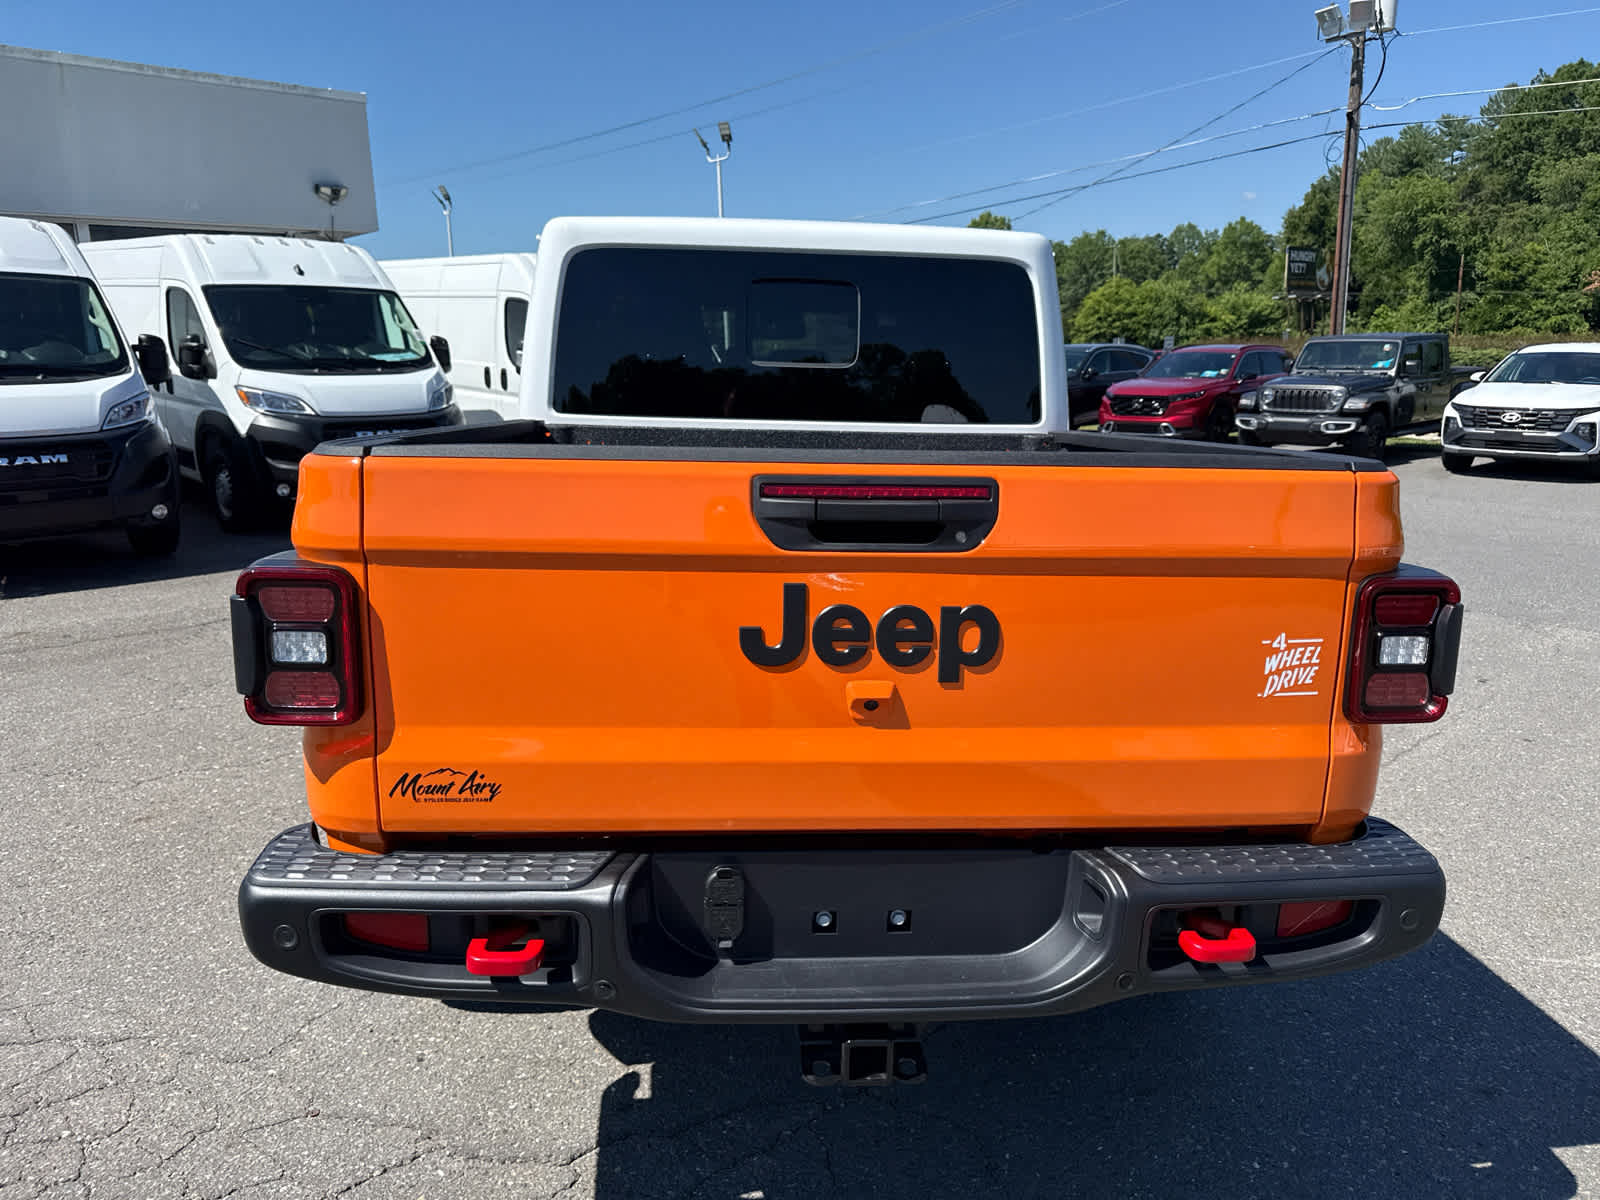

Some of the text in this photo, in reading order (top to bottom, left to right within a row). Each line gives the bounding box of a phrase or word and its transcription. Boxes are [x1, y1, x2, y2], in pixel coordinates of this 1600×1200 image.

[738, 583, 1000, 683] Jeep
[1271, 632, 1287, 650] 4
[1264, 646, 1321, 675] WHEEL
[1263, 666, 1319, 698] DRIVE
[388, 770, 502, 802] Mount Airy
